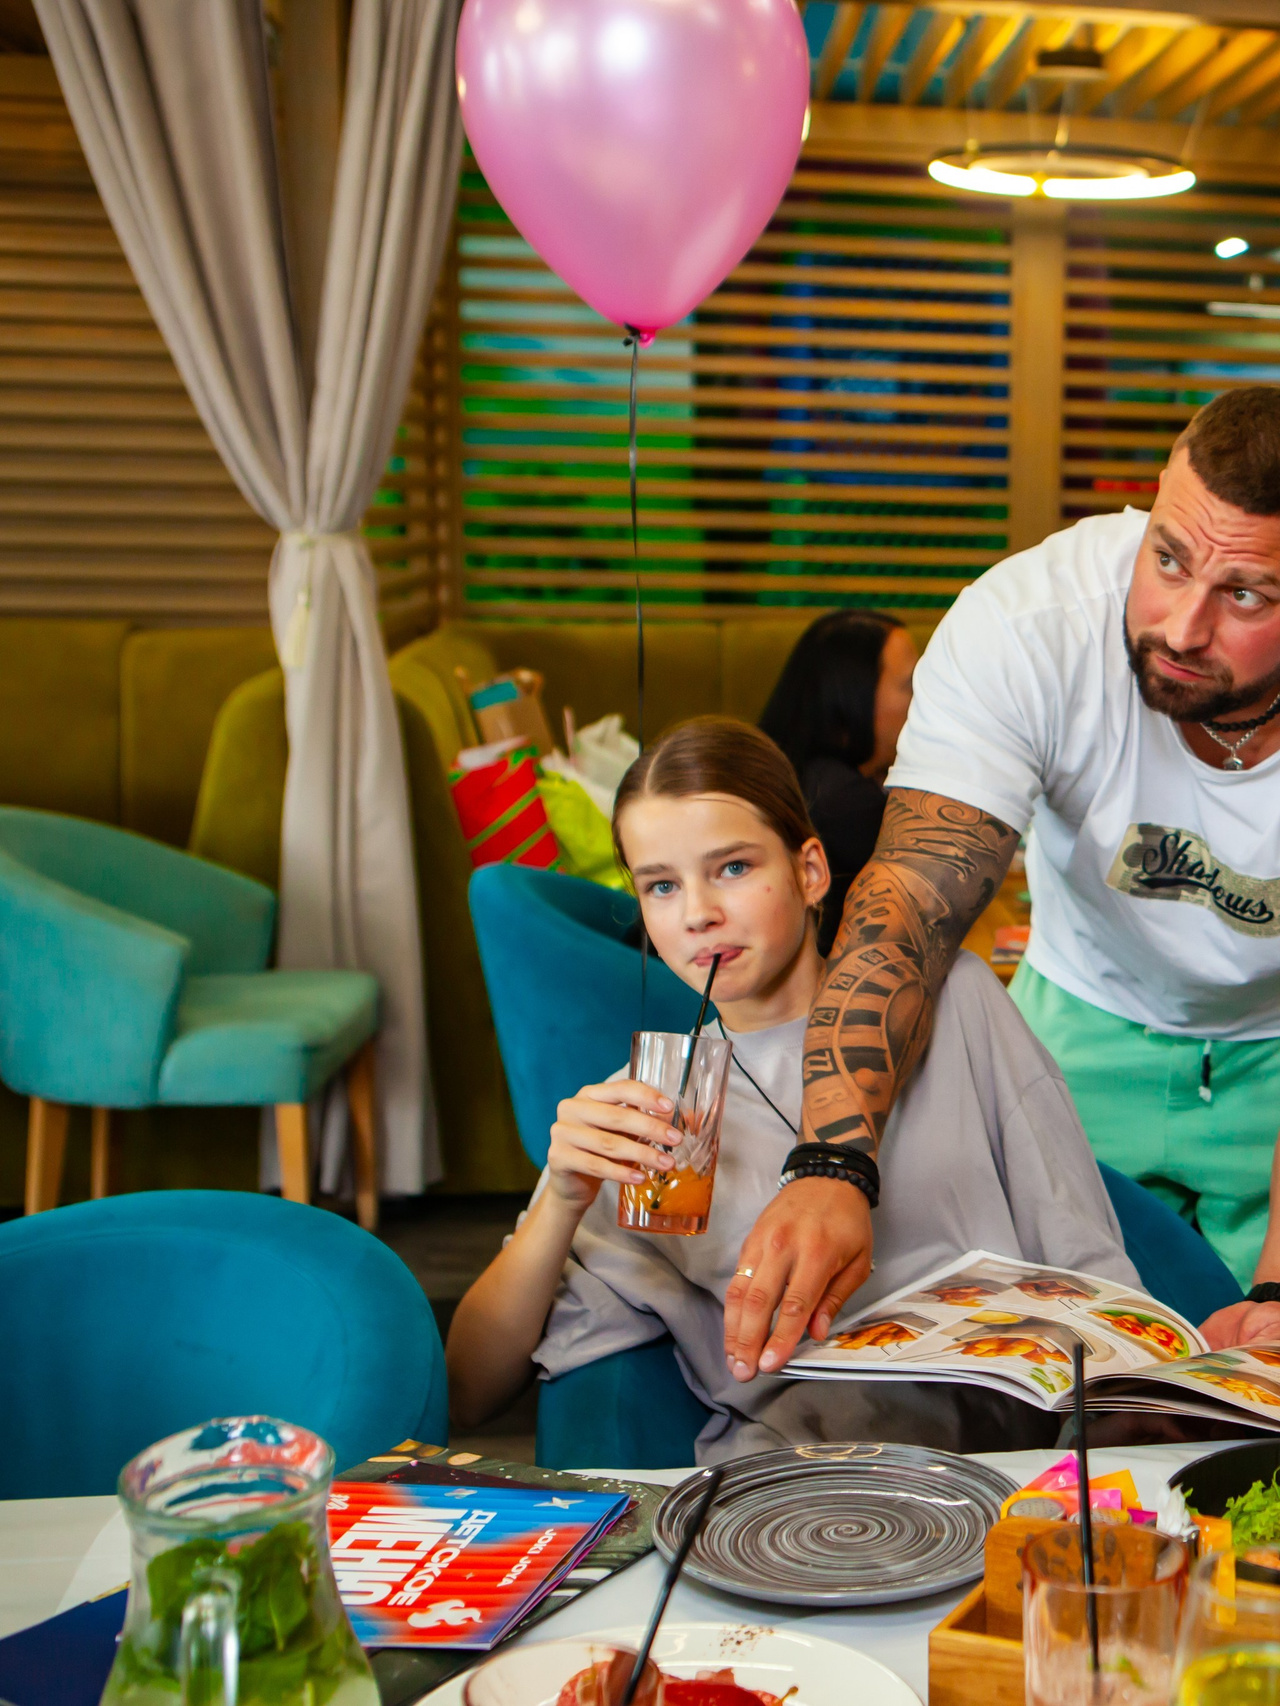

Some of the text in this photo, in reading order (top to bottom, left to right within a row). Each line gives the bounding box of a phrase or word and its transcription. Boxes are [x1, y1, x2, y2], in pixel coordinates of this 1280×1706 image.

[830, 974, 853, 990] 28
[809, 1009, 837, 1025] 29
[803, 1050, 834, 1081] 22
[387, 1509, 497, 1606] ДЕТСКОЕ
[496, 1528, 557, 1588] JOKI JOYA
